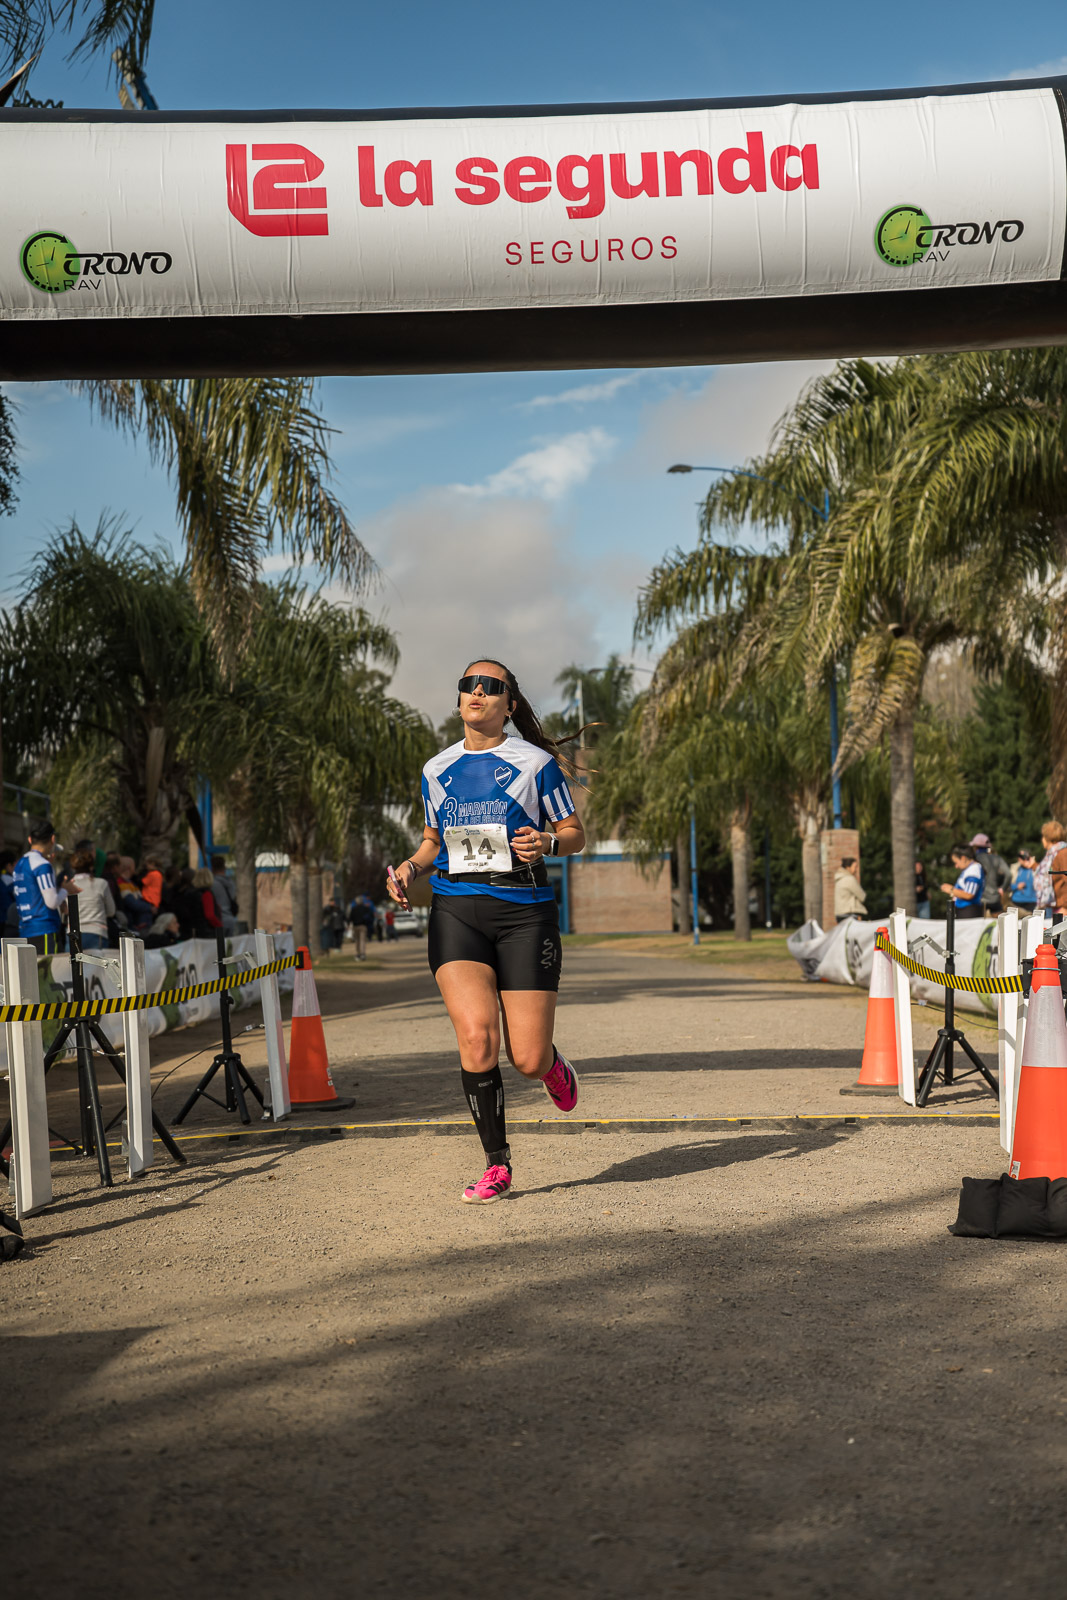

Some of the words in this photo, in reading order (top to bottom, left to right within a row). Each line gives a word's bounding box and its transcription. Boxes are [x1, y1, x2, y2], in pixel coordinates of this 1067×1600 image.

[358, 145, 434, 207] la
[454, 131, 820, 220] segunda
[505, 236, 678, 265] SEGUROS
[912, 250, 951, 264] RAV
[63, 279, 102, 291] RAV
[443, 797, 457, 829] 3
[457, 799, 508, 818] MARATÓN
[460, 838, 496, 860] 14
